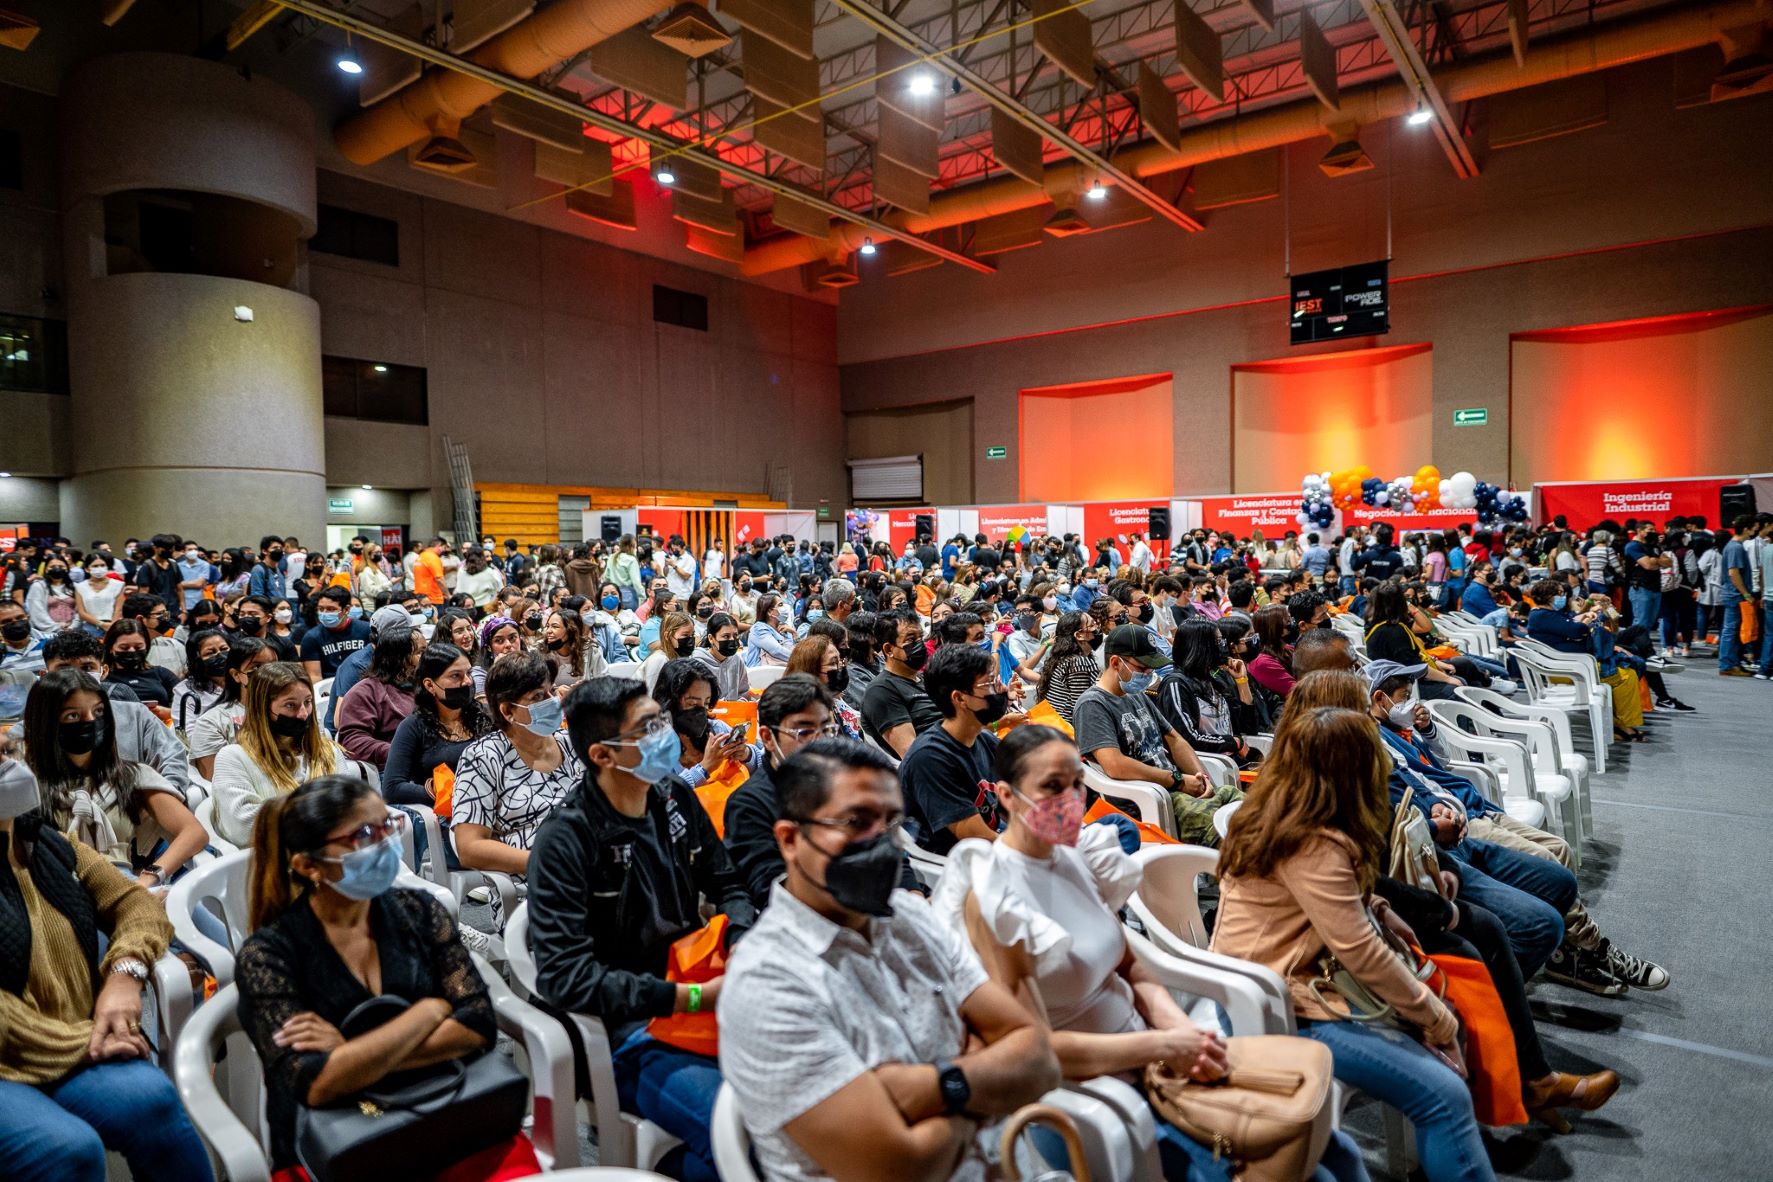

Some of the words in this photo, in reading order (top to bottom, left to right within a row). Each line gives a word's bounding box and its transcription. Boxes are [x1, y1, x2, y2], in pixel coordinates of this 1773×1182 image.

[1344, 290, 1382, 302] POWER
[1294, 298, 1322, 311] IEST
[1603, 490, 1672, 504] Ingeniería
[1233, 499, 1292, 508] Licenciatura
[1604, 501, 1670, 513] Industrial
[1218, 509, 1260, 518] Finanzas
[1261, 509, 1267, 517] y
[1354, 509, 1401, 520] Negocios
[322, 640, 364, 656] HILFIGER
